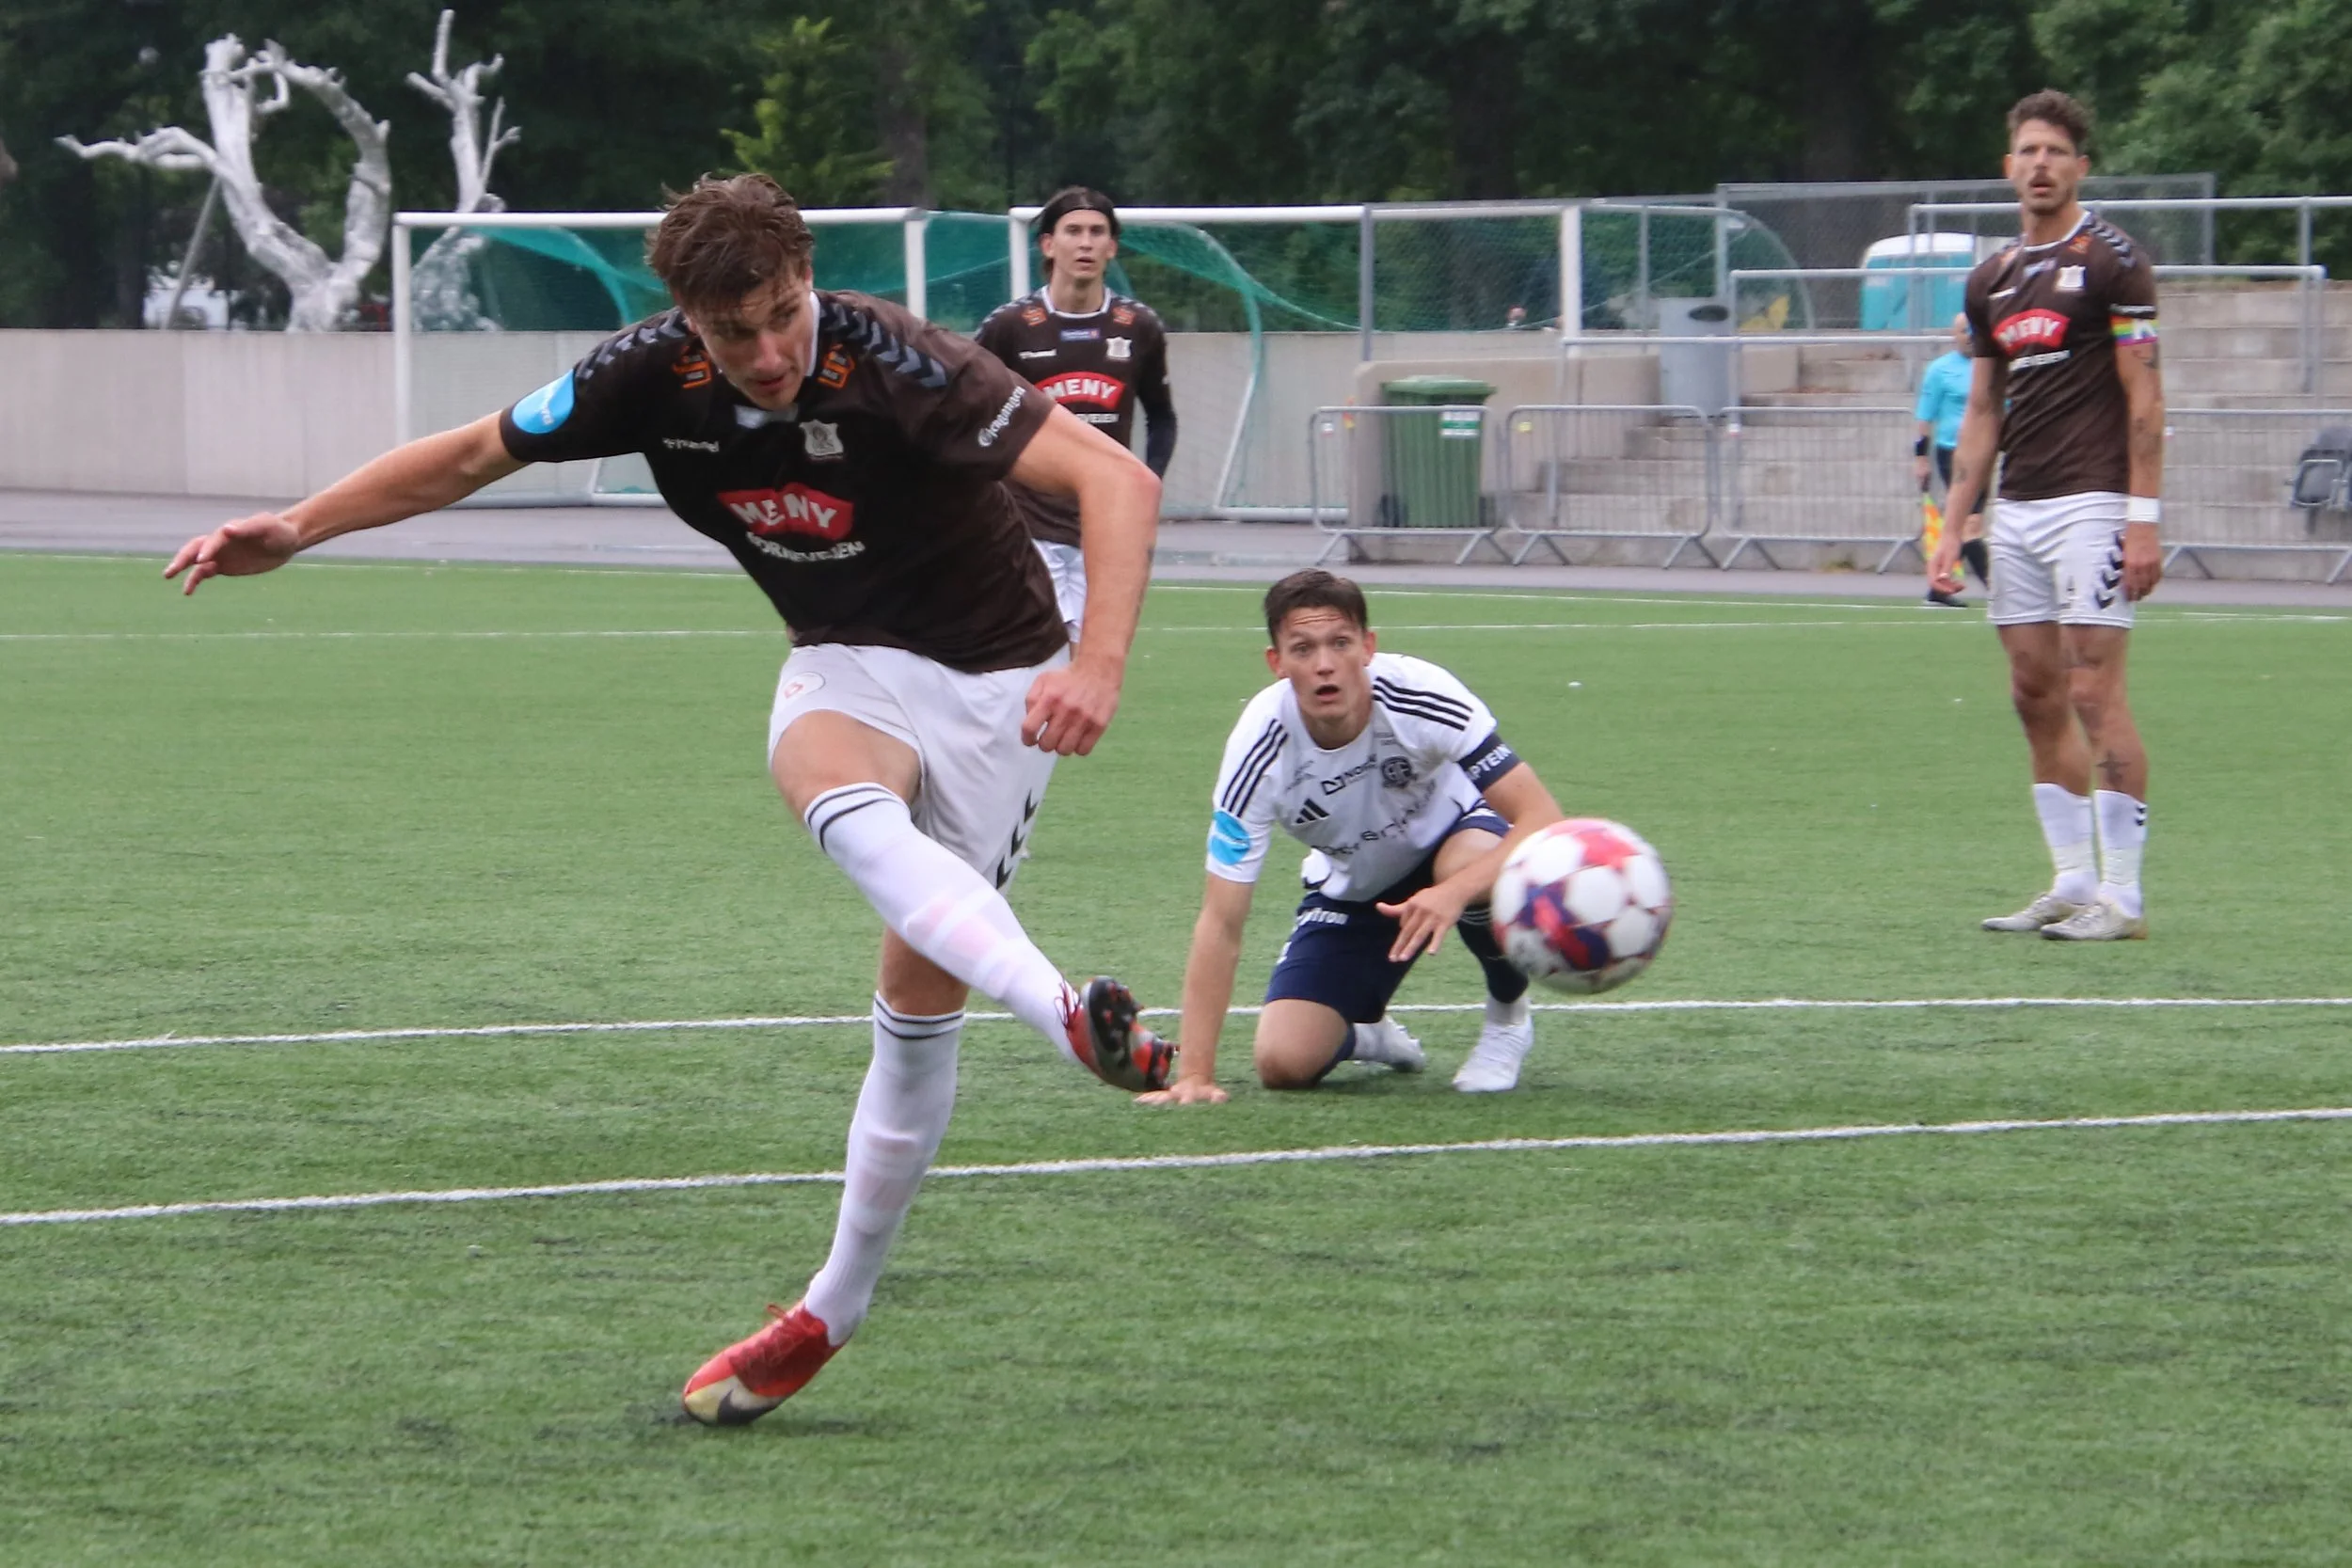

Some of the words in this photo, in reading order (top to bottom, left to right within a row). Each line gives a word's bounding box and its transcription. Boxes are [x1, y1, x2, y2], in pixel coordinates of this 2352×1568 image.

[1042, 378, 1118, 400] MENY
[729, 493, 838, 529] MENY
[1467, 743, 1513, 781] PTEIN
